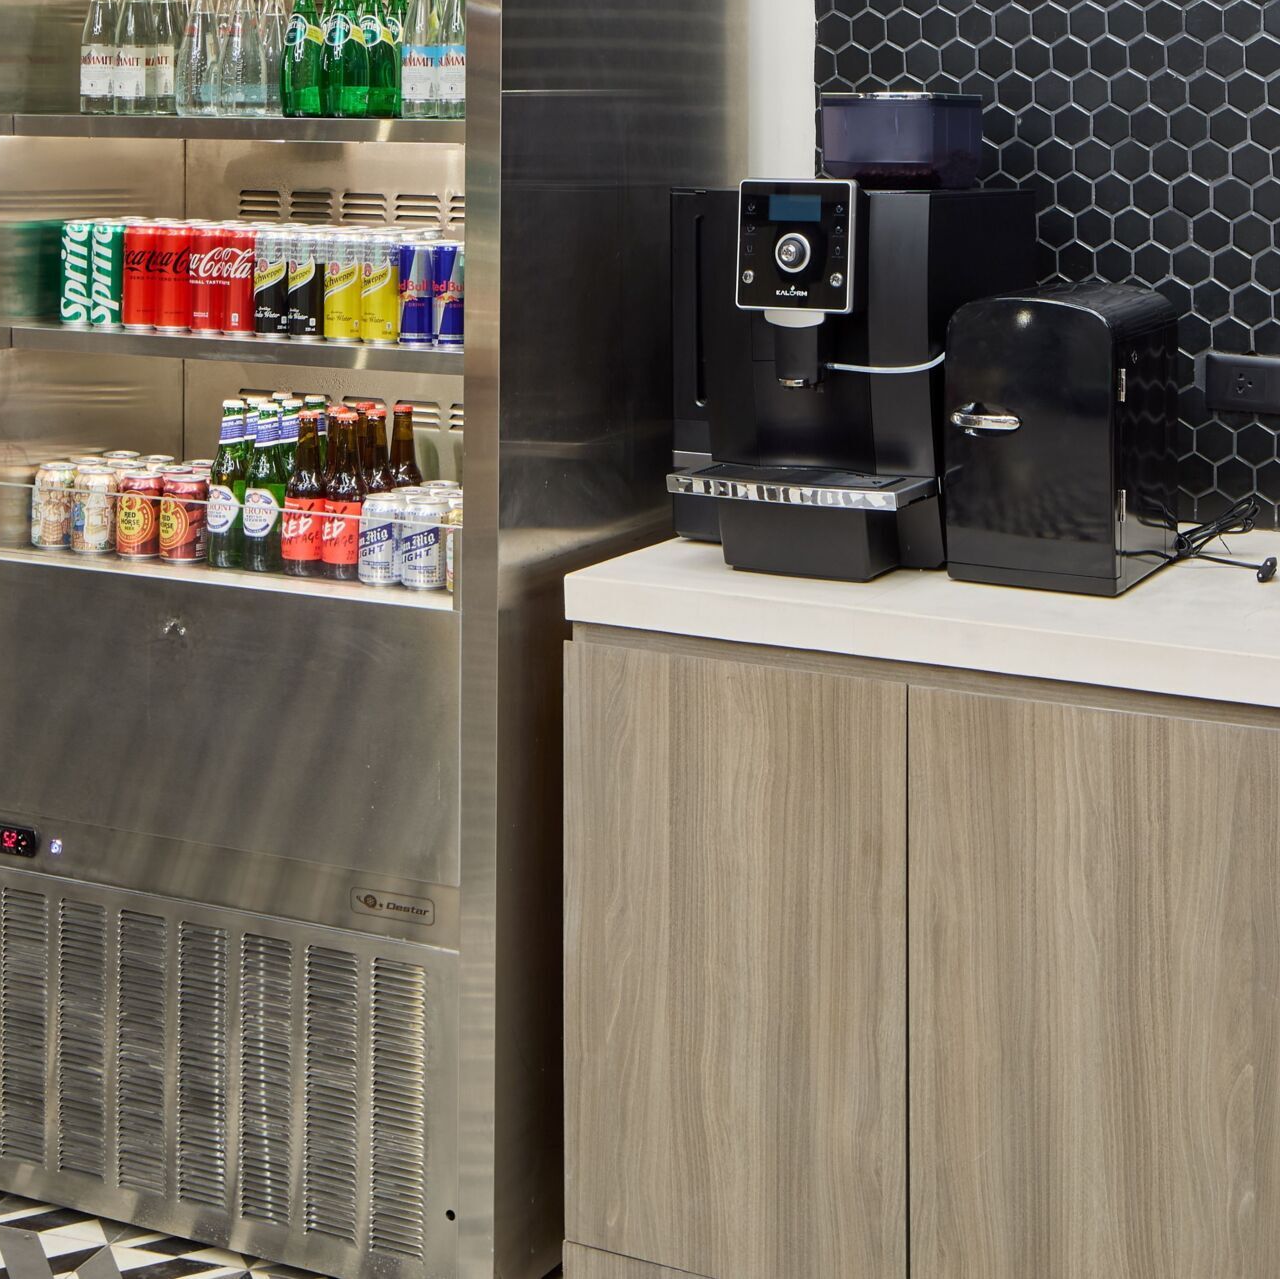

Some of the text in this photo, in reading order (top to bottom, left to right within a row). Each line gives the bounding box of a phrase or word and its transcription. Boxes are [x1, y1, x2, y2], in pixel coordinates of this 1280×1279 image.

[60, 223, 93, 324] Sprite
[124, 511, 137, 519] RED
[322, 518, 346, 541] ED
[386, 901, 430, 916] Destar
